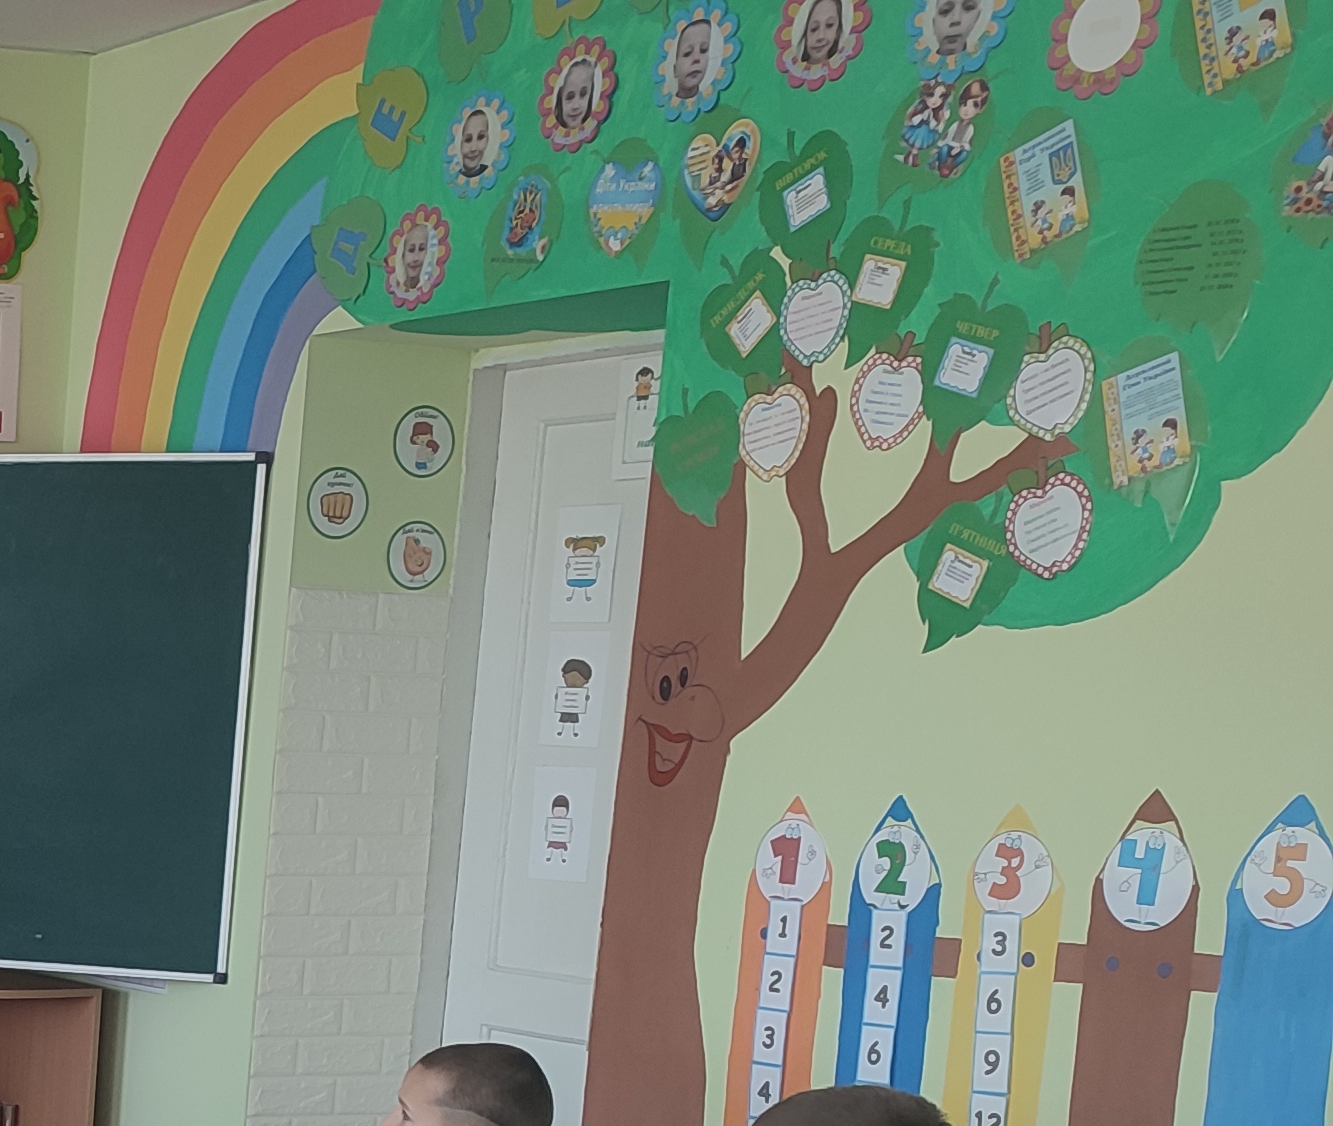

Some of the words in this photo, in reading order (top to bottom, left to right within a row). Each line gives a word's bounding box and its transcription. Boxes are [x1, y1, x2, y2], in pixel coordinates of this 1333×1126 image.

[870, 236, 912, 255] СЕРЕДА
[956, 320, 999, 340] ЧЕТВЕР
[770, 834, 802, 885] 1
[873, 840, 907, 896] 2
[987, 843, 1024, 900] 3
[1117, 838, 1166, 907] 4
[1264, 843, 1308, 908] 5
[778, 915, 788, 938] 1
[880, 925, 894, 949] 2
[991, 931, 1008, 956] 3
[769, 970, 782, 993] 2
[874, 985, 889, 1009] 4
[986, 989, 1002, 1015] 6
[762, 1026, 775, 1049] 3
[867, 1041, 881, 1065] 6
[984, 1050, 1000, 1075] 9
[757, 1081, 771, 1104] 4
